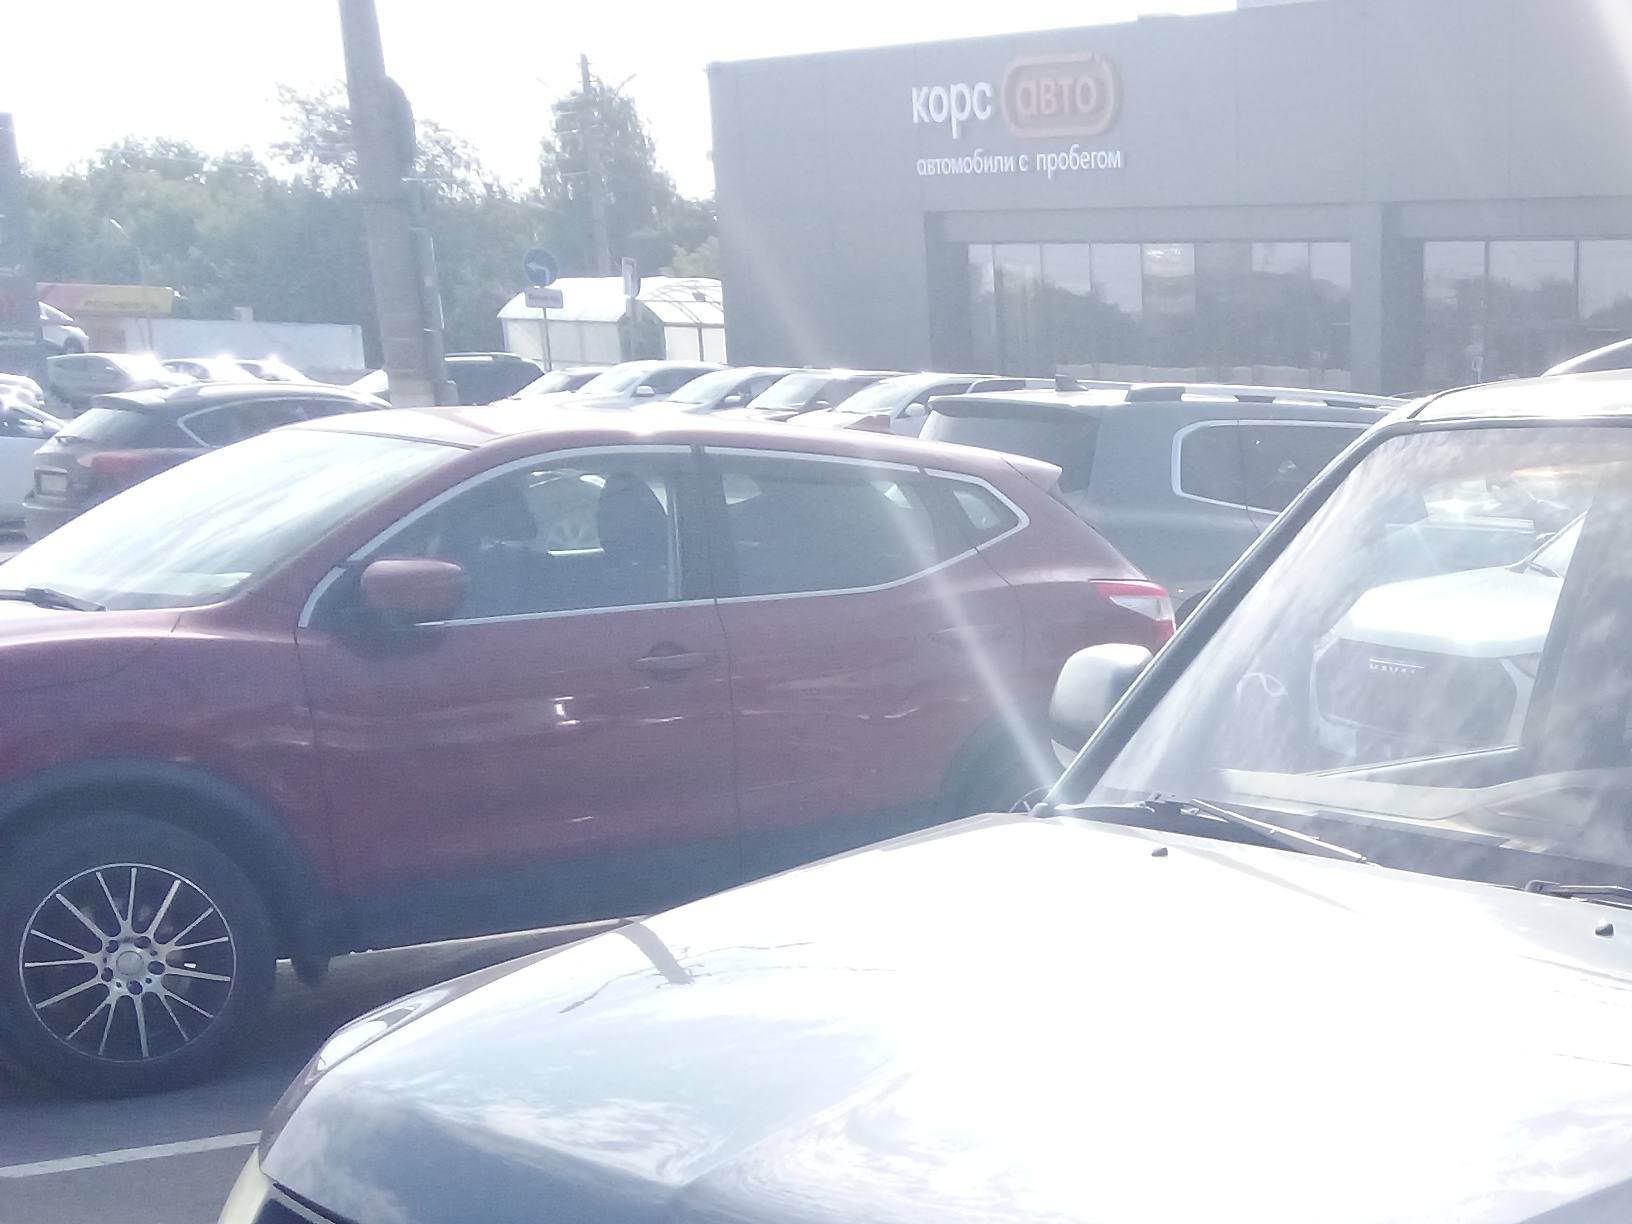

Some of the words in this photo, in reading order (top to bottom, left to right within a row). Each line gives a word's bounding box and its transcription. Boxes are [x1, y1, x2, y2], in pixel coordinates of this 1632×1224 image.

[911, 81, 994, 139] корс
[1015, 75, 1098, 117] авто
[916, 148, 1014, 176] автомобили
[1018, 154, 1029, 171] с
[1036, 143, 1121, 179] пробегом
